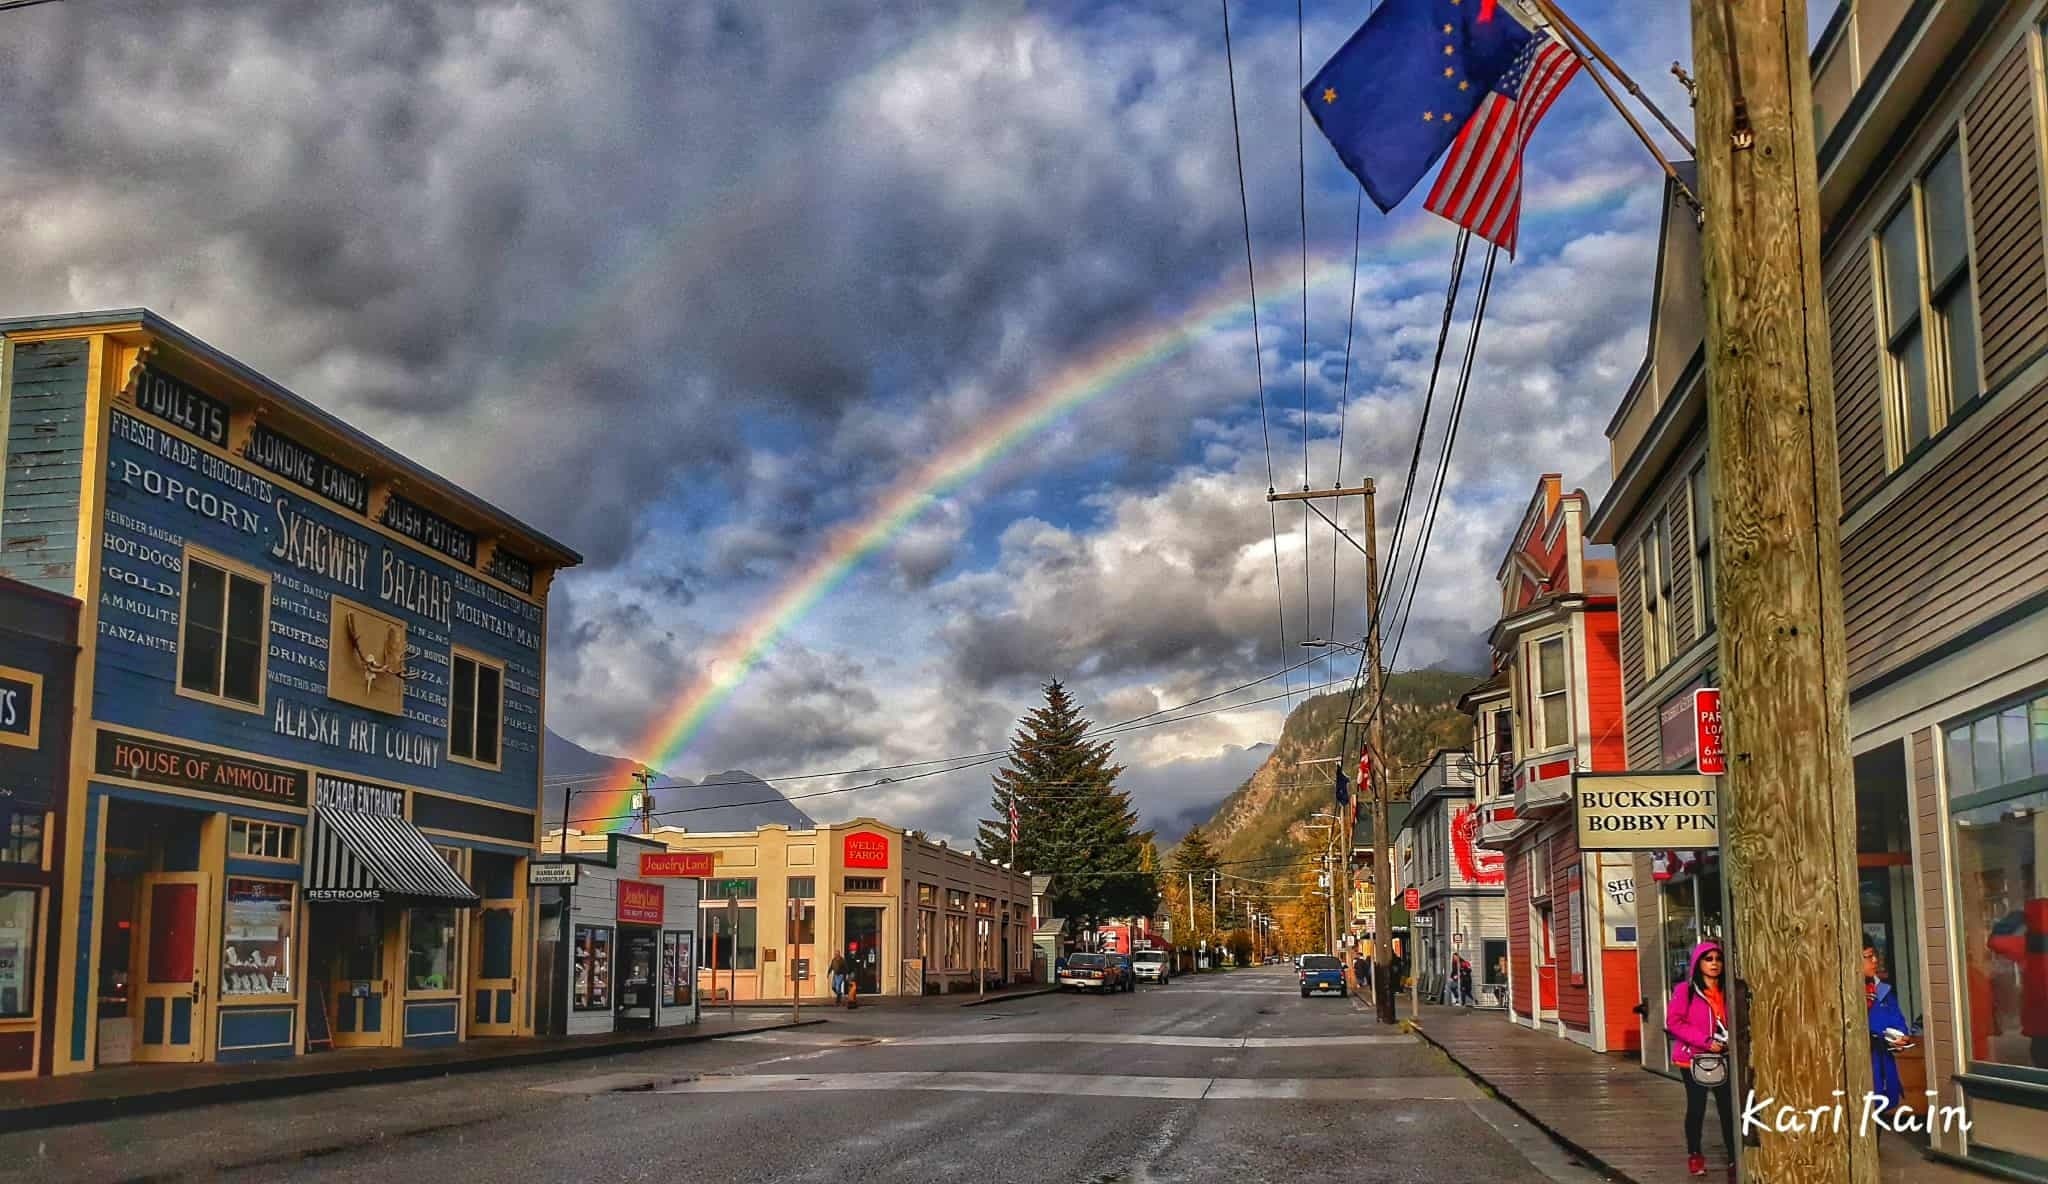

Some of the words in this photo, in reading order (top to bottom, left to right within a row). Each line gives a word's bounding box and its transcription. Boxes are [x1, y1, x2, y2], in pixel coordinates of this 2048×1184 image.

[142, 371, 223, 442] TOILETS
[111, 411, 155, 450] FRESH
[159, 432, 198, 471] MADE
[202, 454, 273, 504] CHOCOLATES
[246, 432, 315, 485] KLONDIKE
[321, 465, 366, 511] CANDY
[121, 458, 261, 535] POPCORN
[105, 509, 147, 533] REINDEER
[148, 525, 184, 547] SAUSAGE
[388, 499, 422, 536] OLISH
[425, 518, 472, 561] POTTERY
[104, 532, 137, 556] HOT
[139, 546, 182, 573] DOGS
[272, 498, 368, 590] SKAGWAY
[380, 549, 451, 632] BAZAAR
[109, 566, 174, 596] GOLD
[273, 571, 300, 590] MADE
[303, 584, 330, 600] DAILY
[101, 592, 178, 625] AMMOLITE
[272, 594, 328, 624] BRITTLES
[456, 601, 514, 640] MOUNTAIN
[517, 627, 540, 649] MAN
[98, 620, 177, 653] TANZANITE
[271, 620, 328, 649] TRUFFLES
[270, 645, 327, 672] DRINKS
[409, 666, 443, 686] PIZZA
[403, 685, 448, 708] ELIXERS
[274, 697, 340, 747] ALASKA
[349, 720, 378, 755] ART
[385, 727, 441, 769] COLONY
[115, 745, 180, 776] HOUSE
[185, 759, 210, 780] OF
[214, 762, 296, 797] AMMOLITE
[317, 777, 355, 813] BAZAAR
[357, 785, 402, 819] ENTRANCE
[1581, 790, 1716, 808] BUCKSHOT
[1588, 815, 1669, 831] BOBBY
[848, 850, 884, 860] FARGO
[849, 841, 885, 850] WELLS
[686, 856, 709, 870] Land
[309, 889, 381, 899] RESTROOMS
